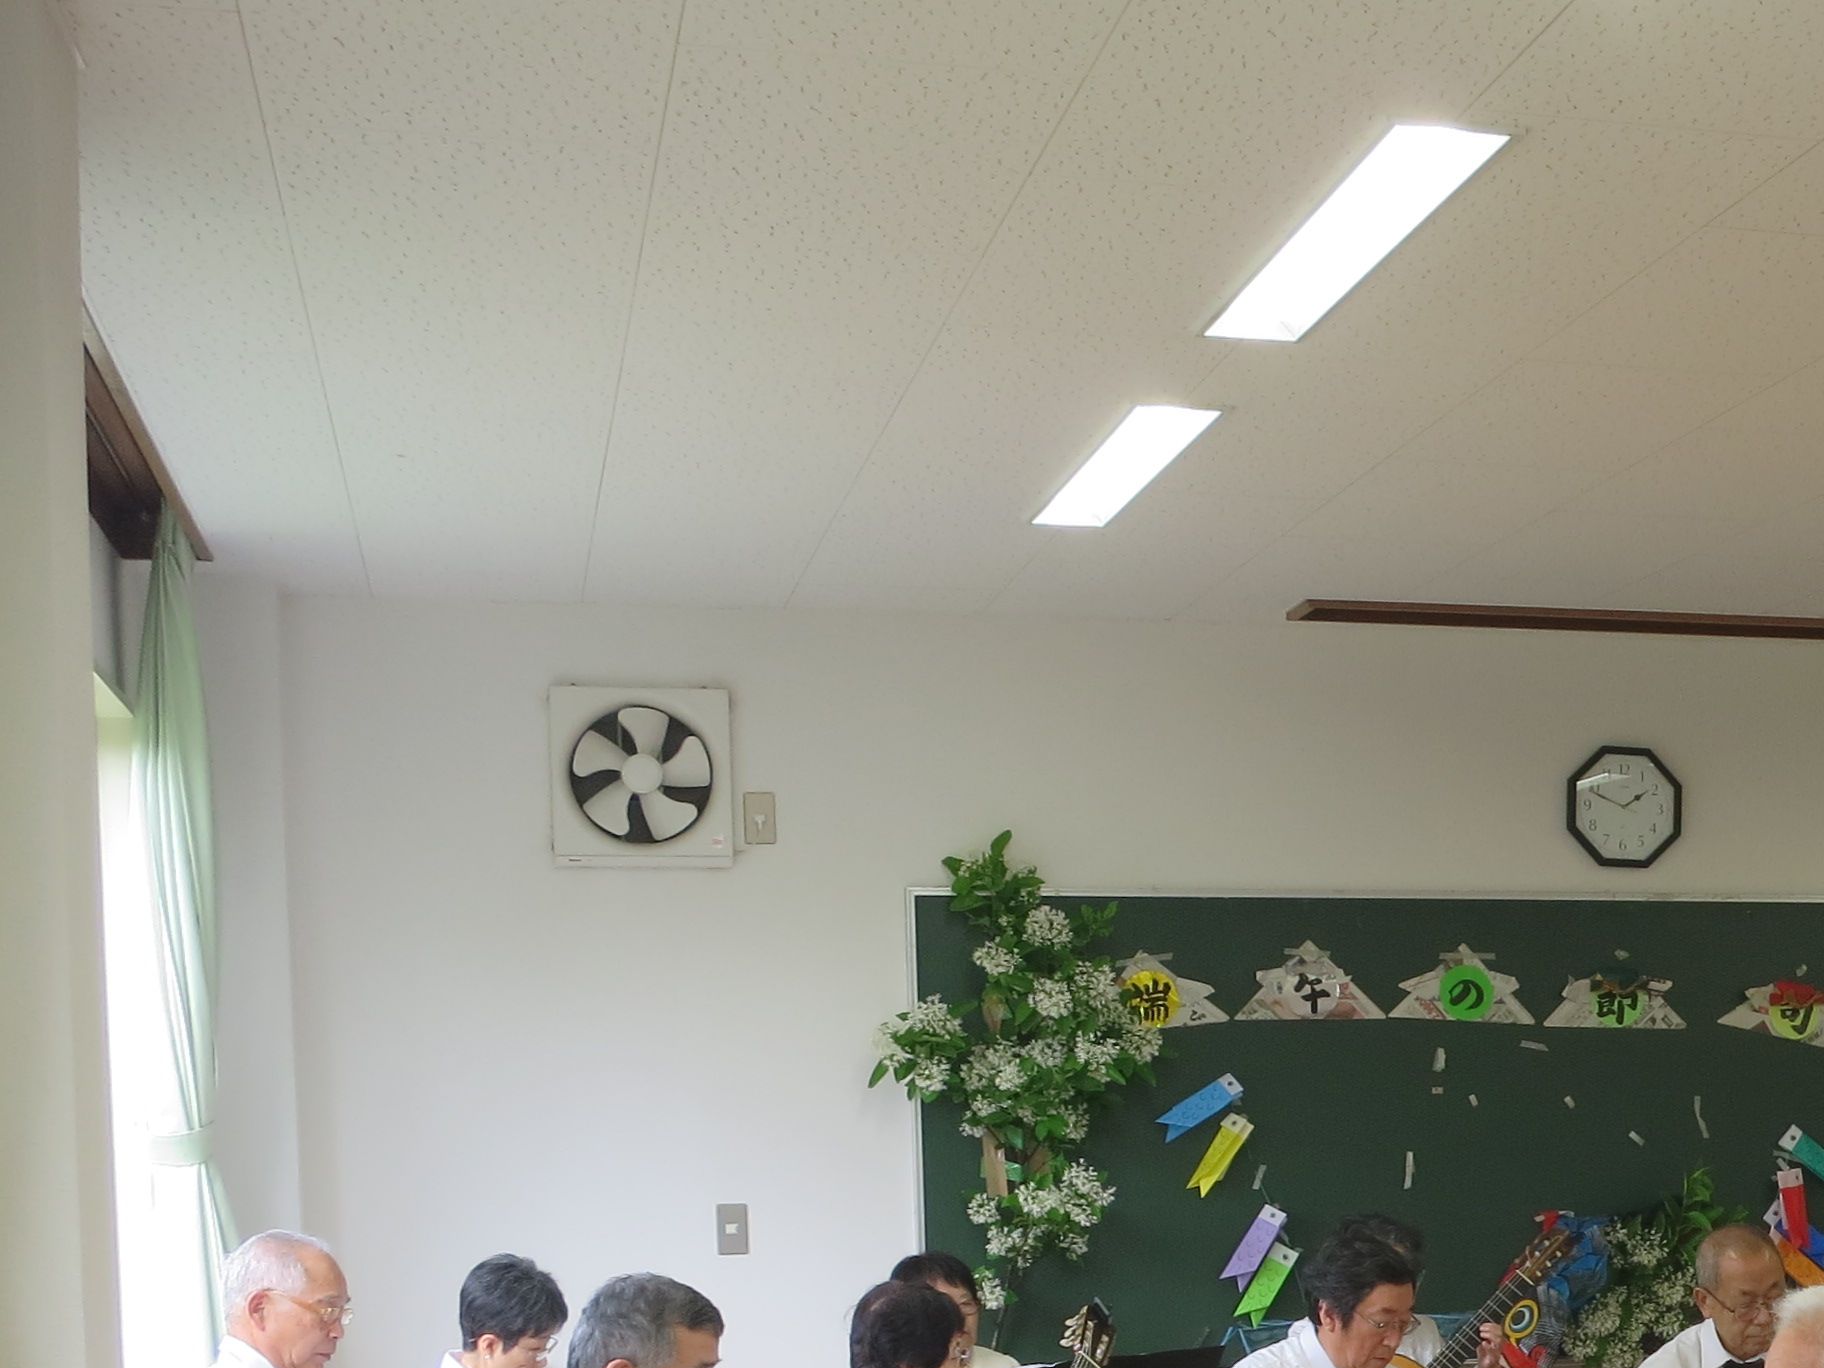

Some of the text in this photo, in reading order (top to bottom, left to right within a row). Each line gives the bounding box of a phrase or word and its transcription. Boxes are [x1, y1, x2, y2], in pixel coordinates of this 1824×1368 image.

[1619, 764, 1630, 775] 12
[1641, 772, 1644, 782] 1
[1652, 784, 1658, 795] 2
[1584, 800, 1591, 810] 9
[1658, 805, 1664, 814] 3
[1589, 820, 1597, 831] 8
[1650, 824, 1656, 834] 4
[1603, 834, 1609, 845] 7
[1619, 839, 1627, 850] 6
[1638, 836, 1644, 846] 5
